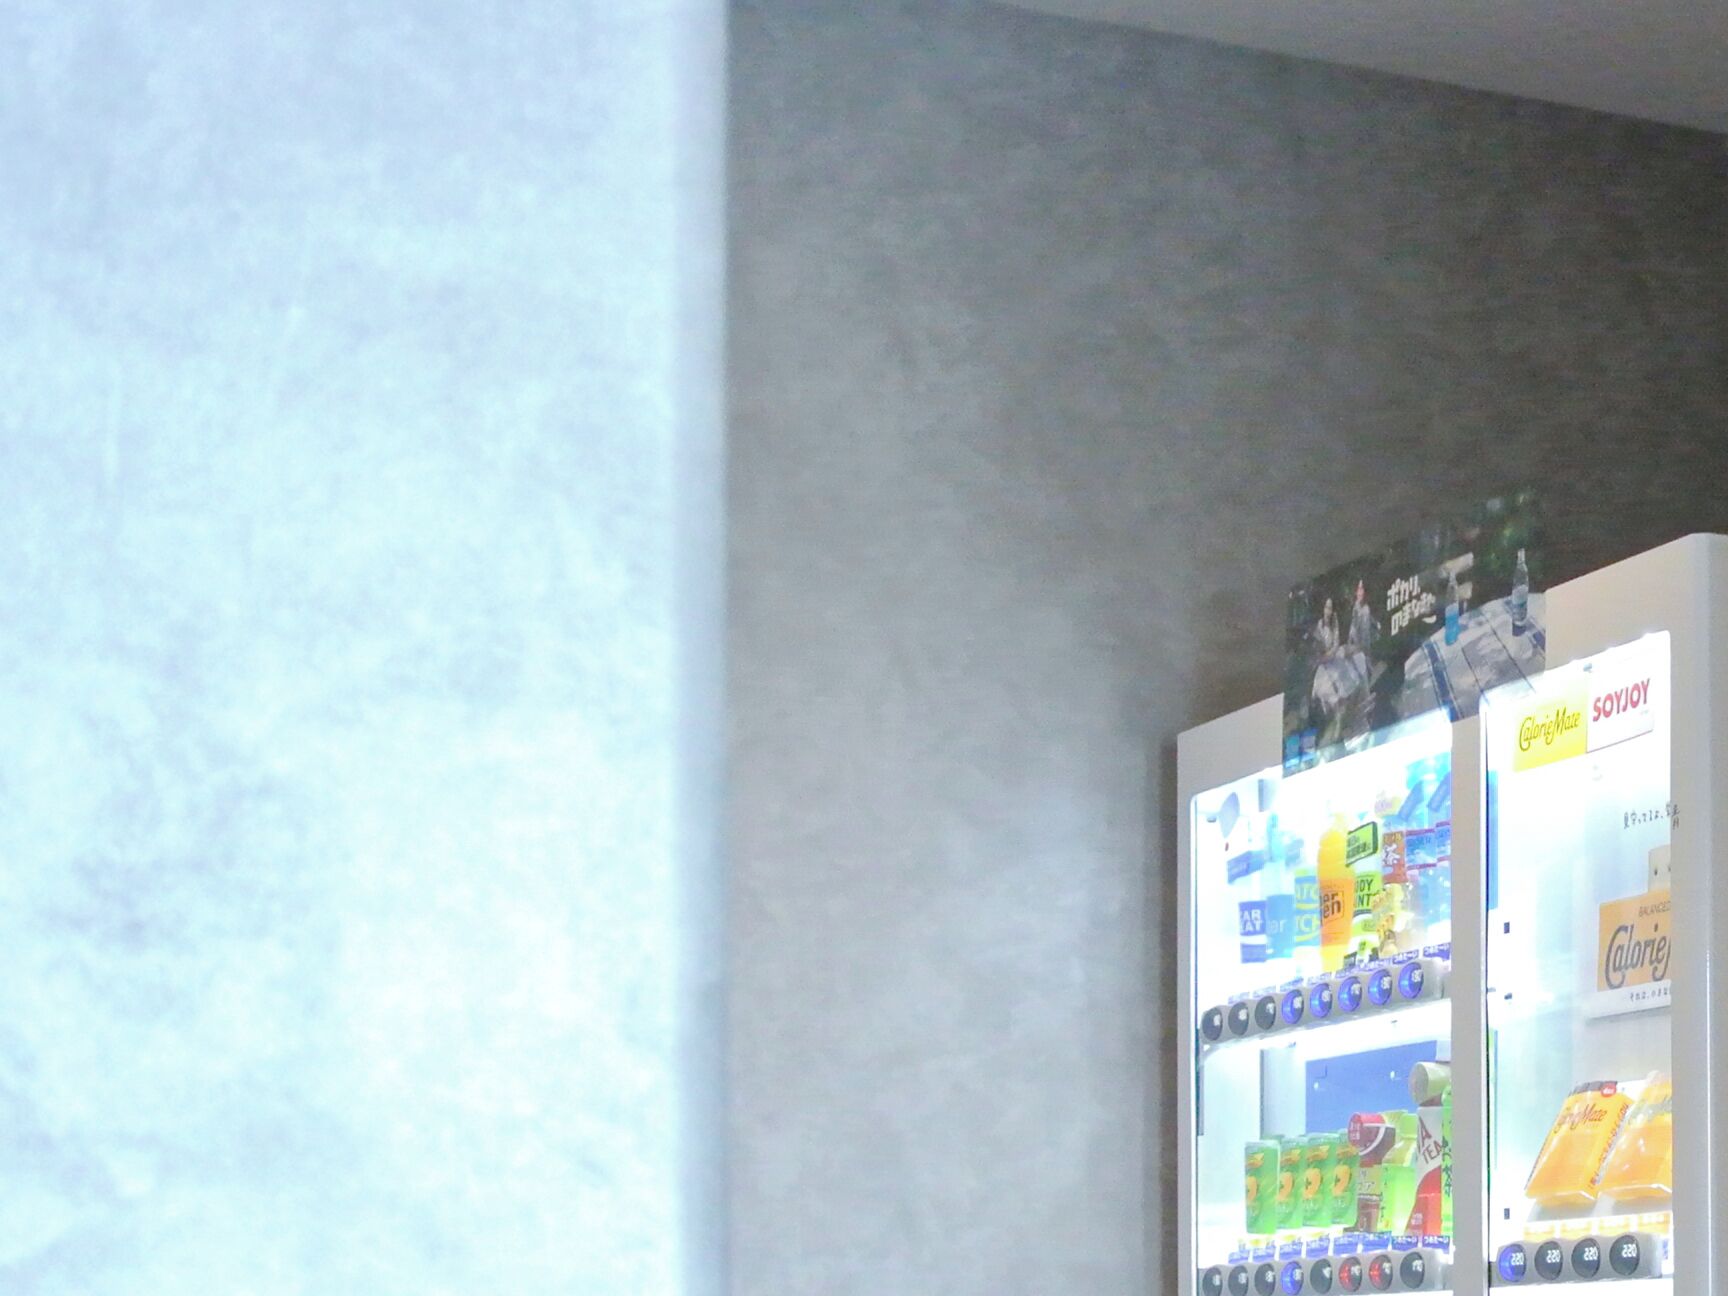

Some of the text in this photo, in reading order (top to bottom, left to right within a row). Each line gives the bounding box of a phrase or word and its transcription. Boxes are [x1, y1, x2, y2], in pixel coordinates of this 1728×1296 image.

[1592, 678, 1651, 723] SOYJOY
[1519, 706, 1581, 752] CalorieMate
[1546, 1250, 1561, 1263] 220
[1583, 1246, 1599, 1261] 220
[1621, 1244, 1638, 1258] 220
[1510, 1252, 1525, 1266] 220
